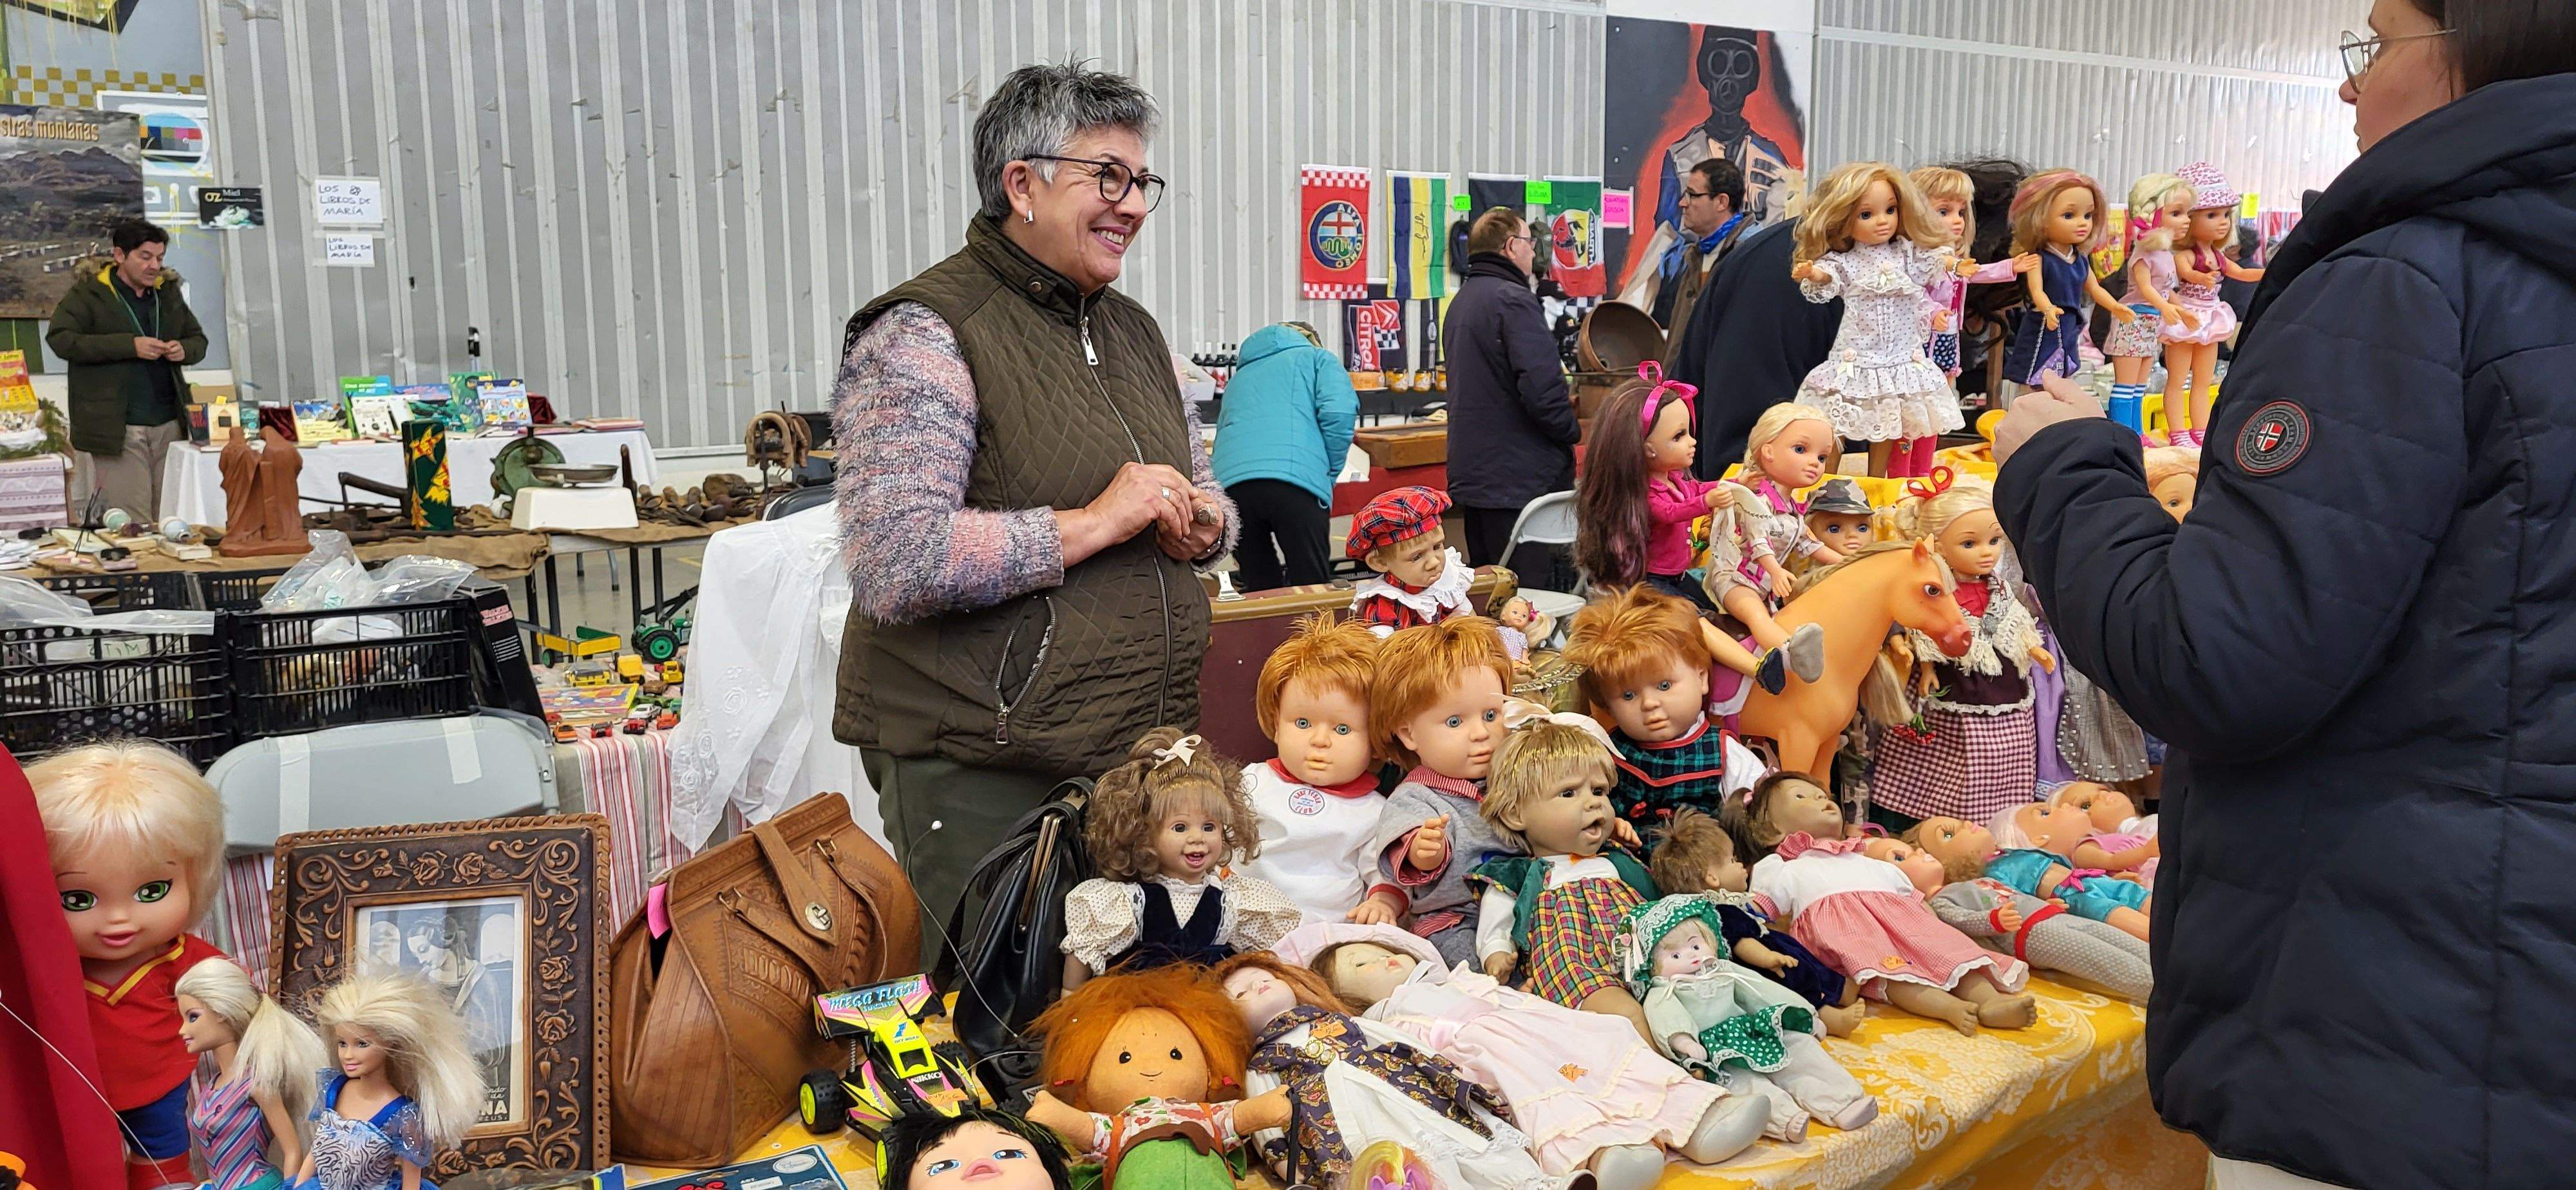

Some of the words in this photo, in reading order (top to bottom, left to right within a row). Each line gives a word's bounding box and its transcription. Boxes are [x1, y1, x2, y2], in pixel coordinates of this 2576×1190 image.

[319, 185, 339, 193] LOS
[319, 196, 356, 204] LIBROS
[910, 1071, 942, 1083] NIKKO
